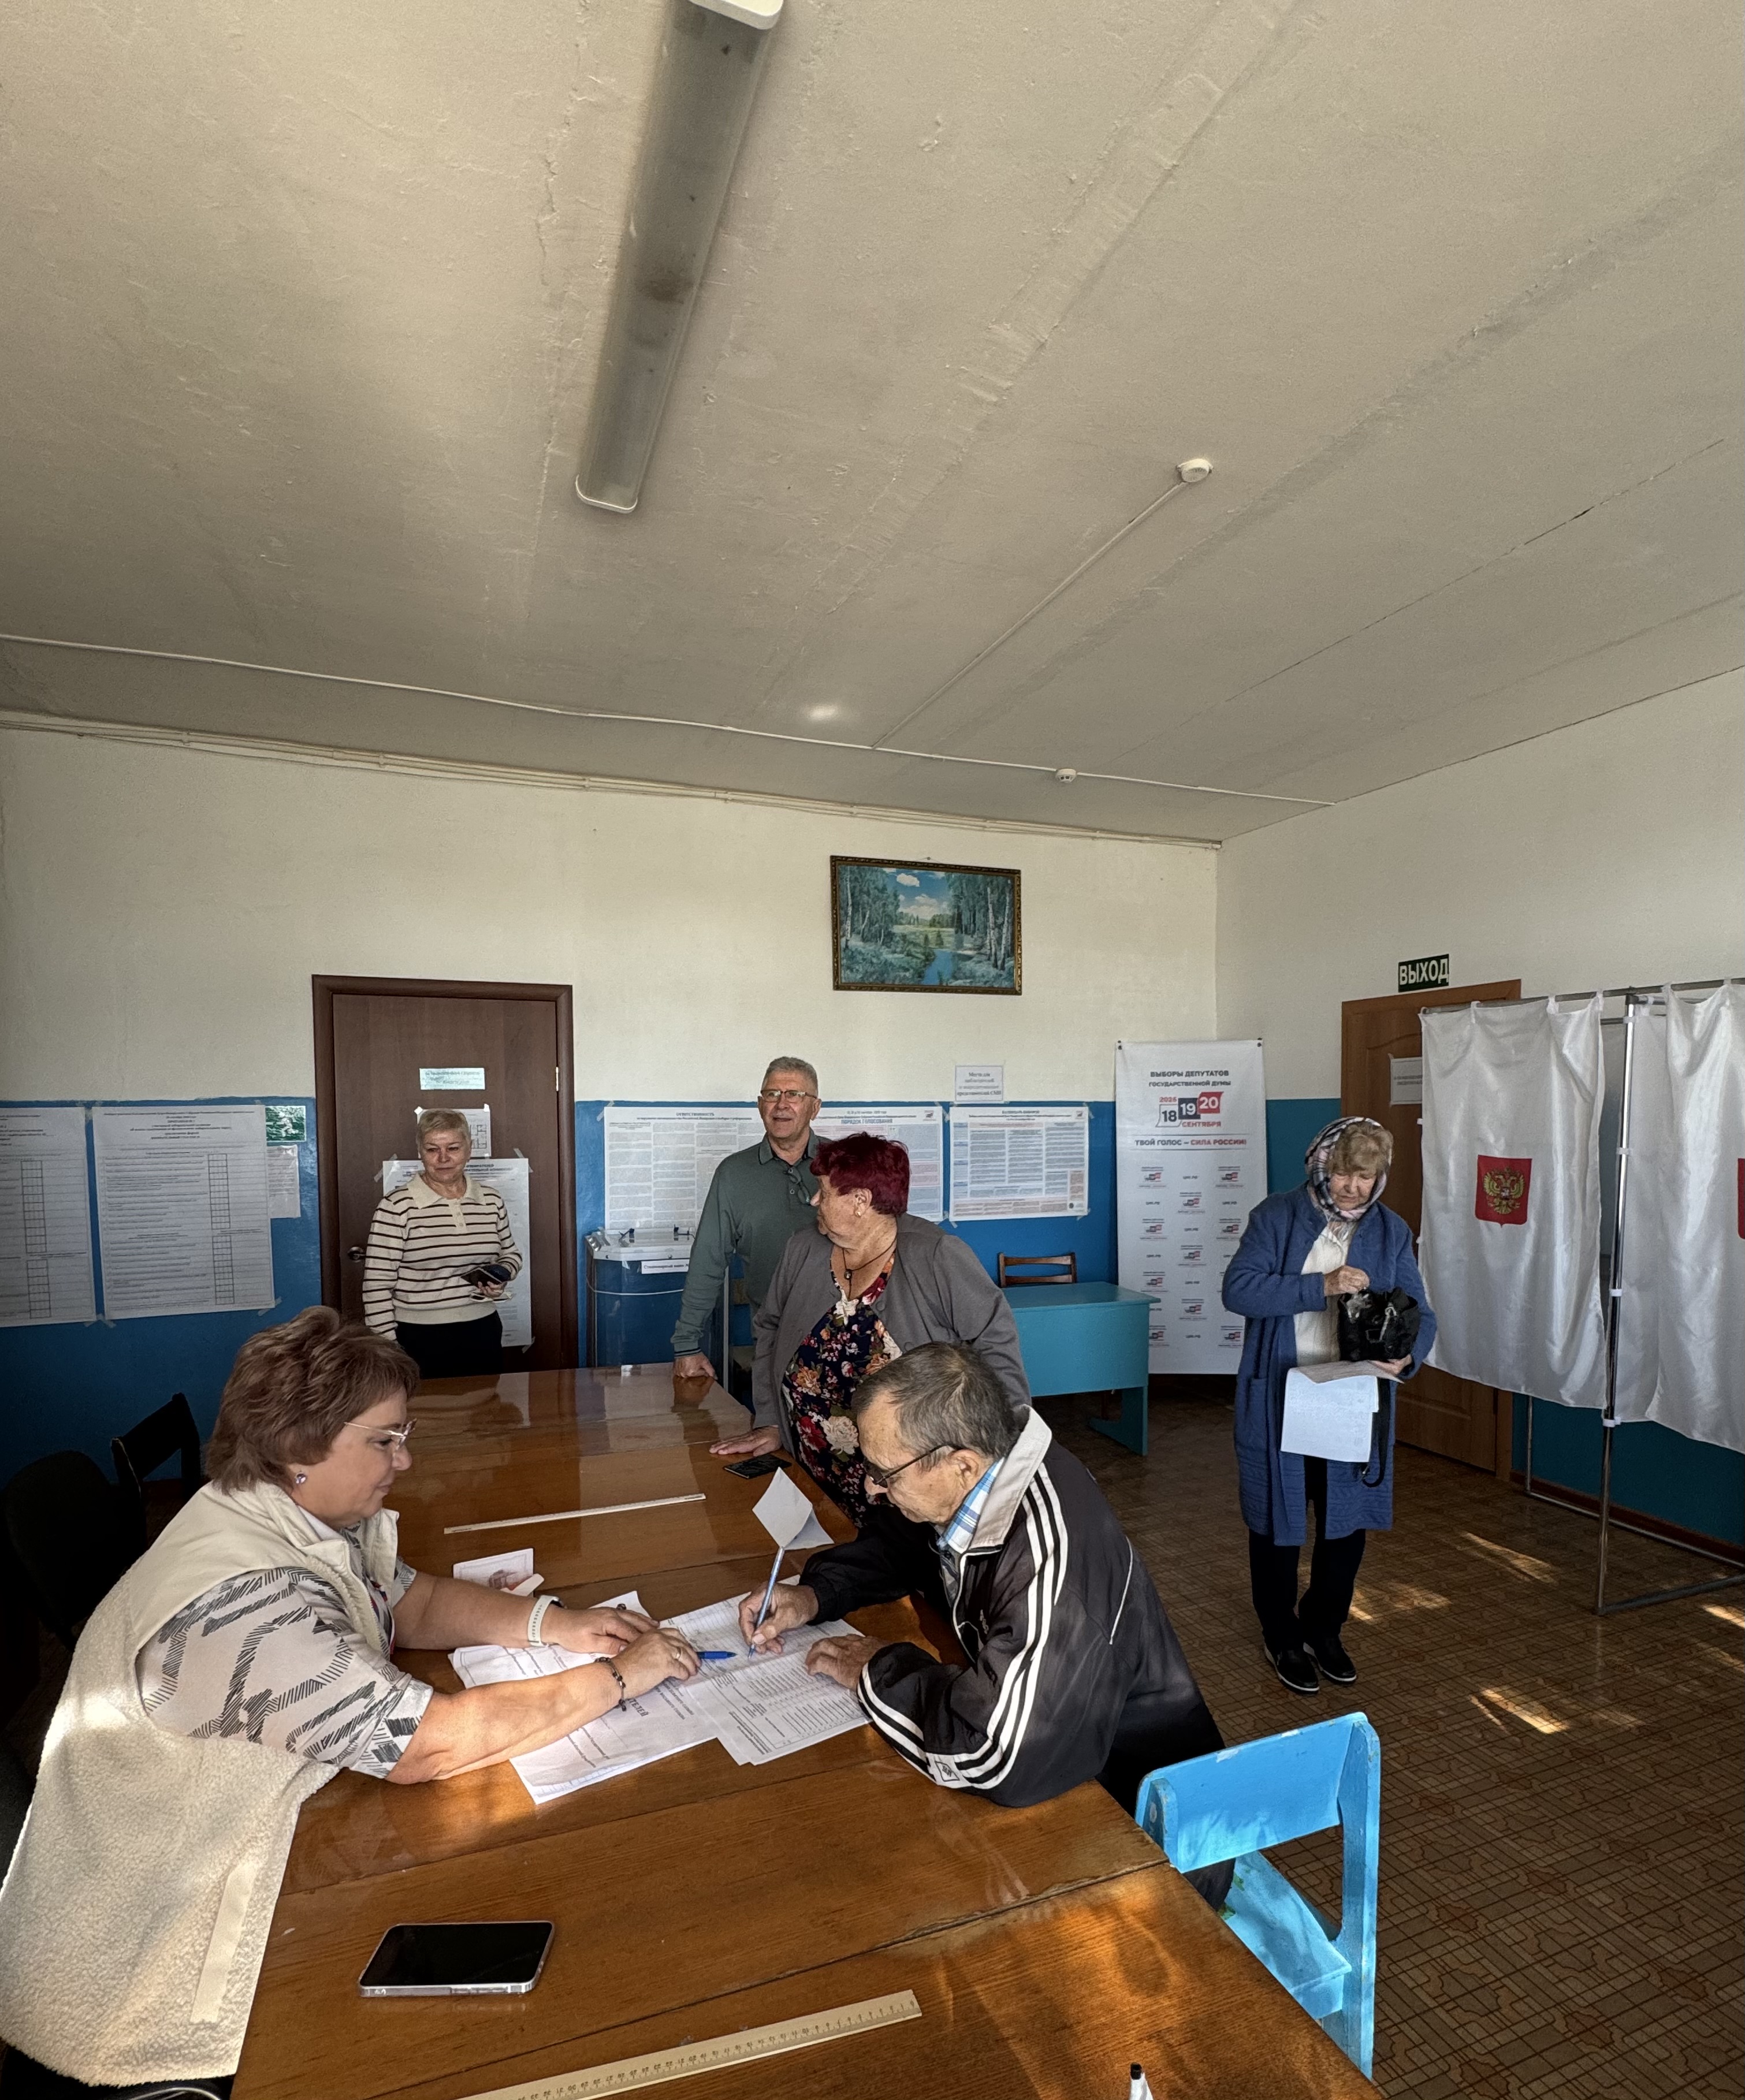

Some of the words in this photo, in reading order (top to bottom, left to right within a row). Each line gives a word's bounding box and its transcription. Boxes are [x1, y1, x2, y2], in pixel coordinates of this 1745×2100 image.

[1399, 959, 1449, 985] ВЫХОД
[1162, 1110, 1177, 1122] 18
[1180, 1103, 1196, 1115] 19
[1199, 1096, 1218, 1109] 20
[628, 1698, 649, 1717] ТЕЛЕЙ
